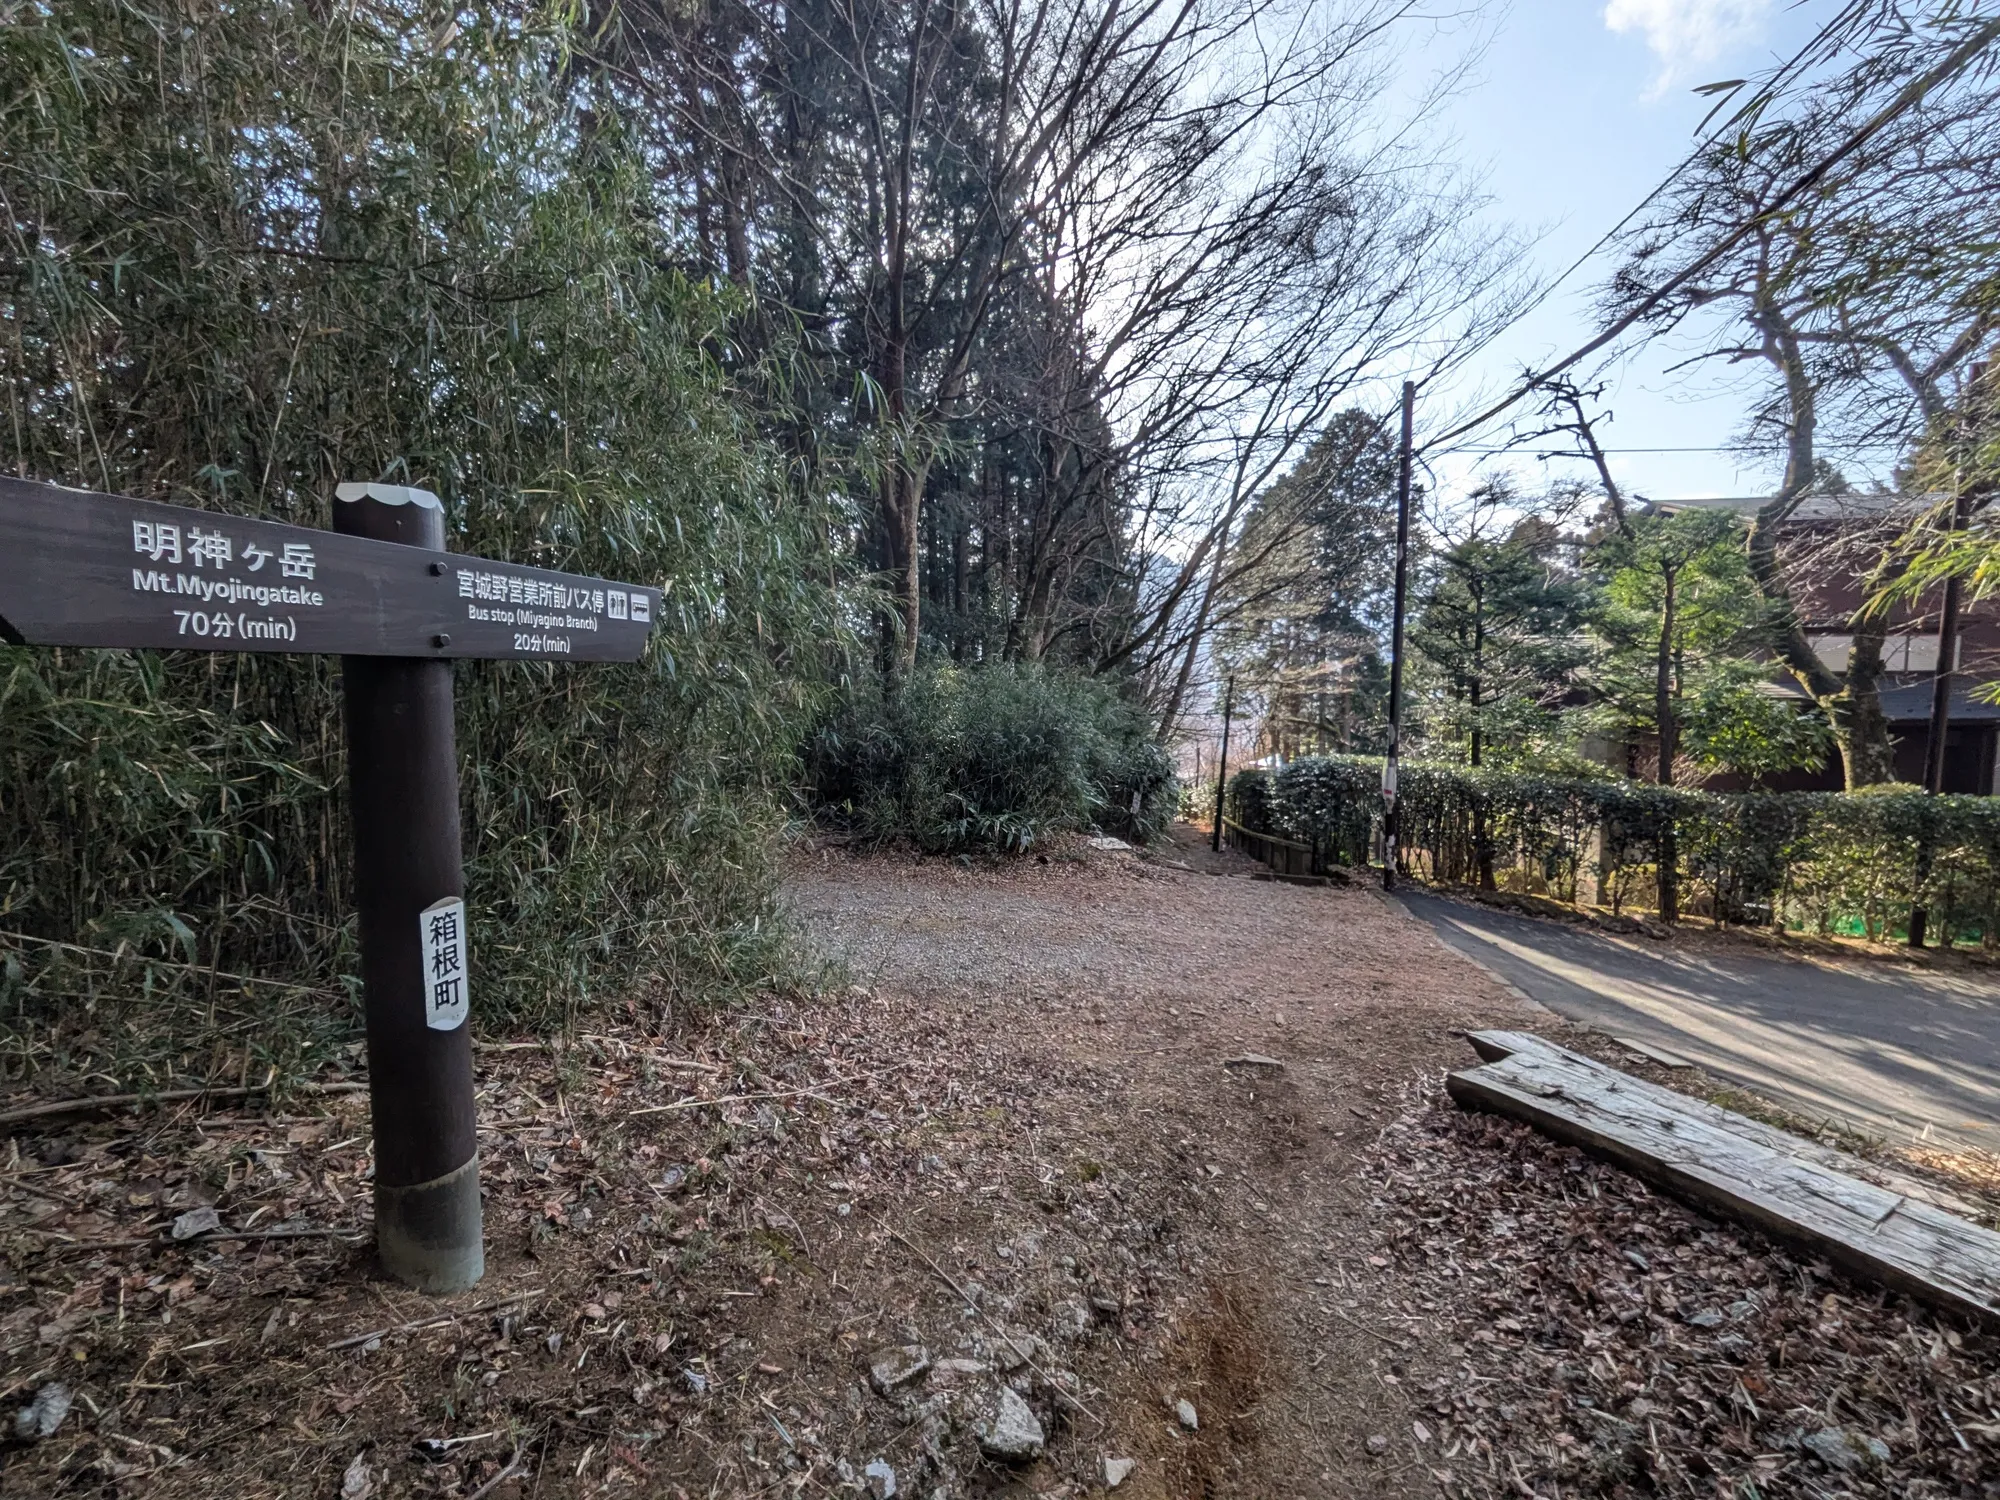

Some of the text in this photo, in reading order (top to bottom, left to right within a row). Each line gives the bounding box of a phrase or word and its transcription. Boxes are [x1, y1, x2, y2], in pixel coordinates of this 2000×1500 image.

[456, 569, 605, 613] 宮城野営業所前バス停
[173, 609, 297, 642] 70分(min)
[468, 604, 598, 632] Bus stop (Miyagino Branch)
[514, 633, 571, 654] 20分(min)
[429, 911, 462, 1010] 箱根町
